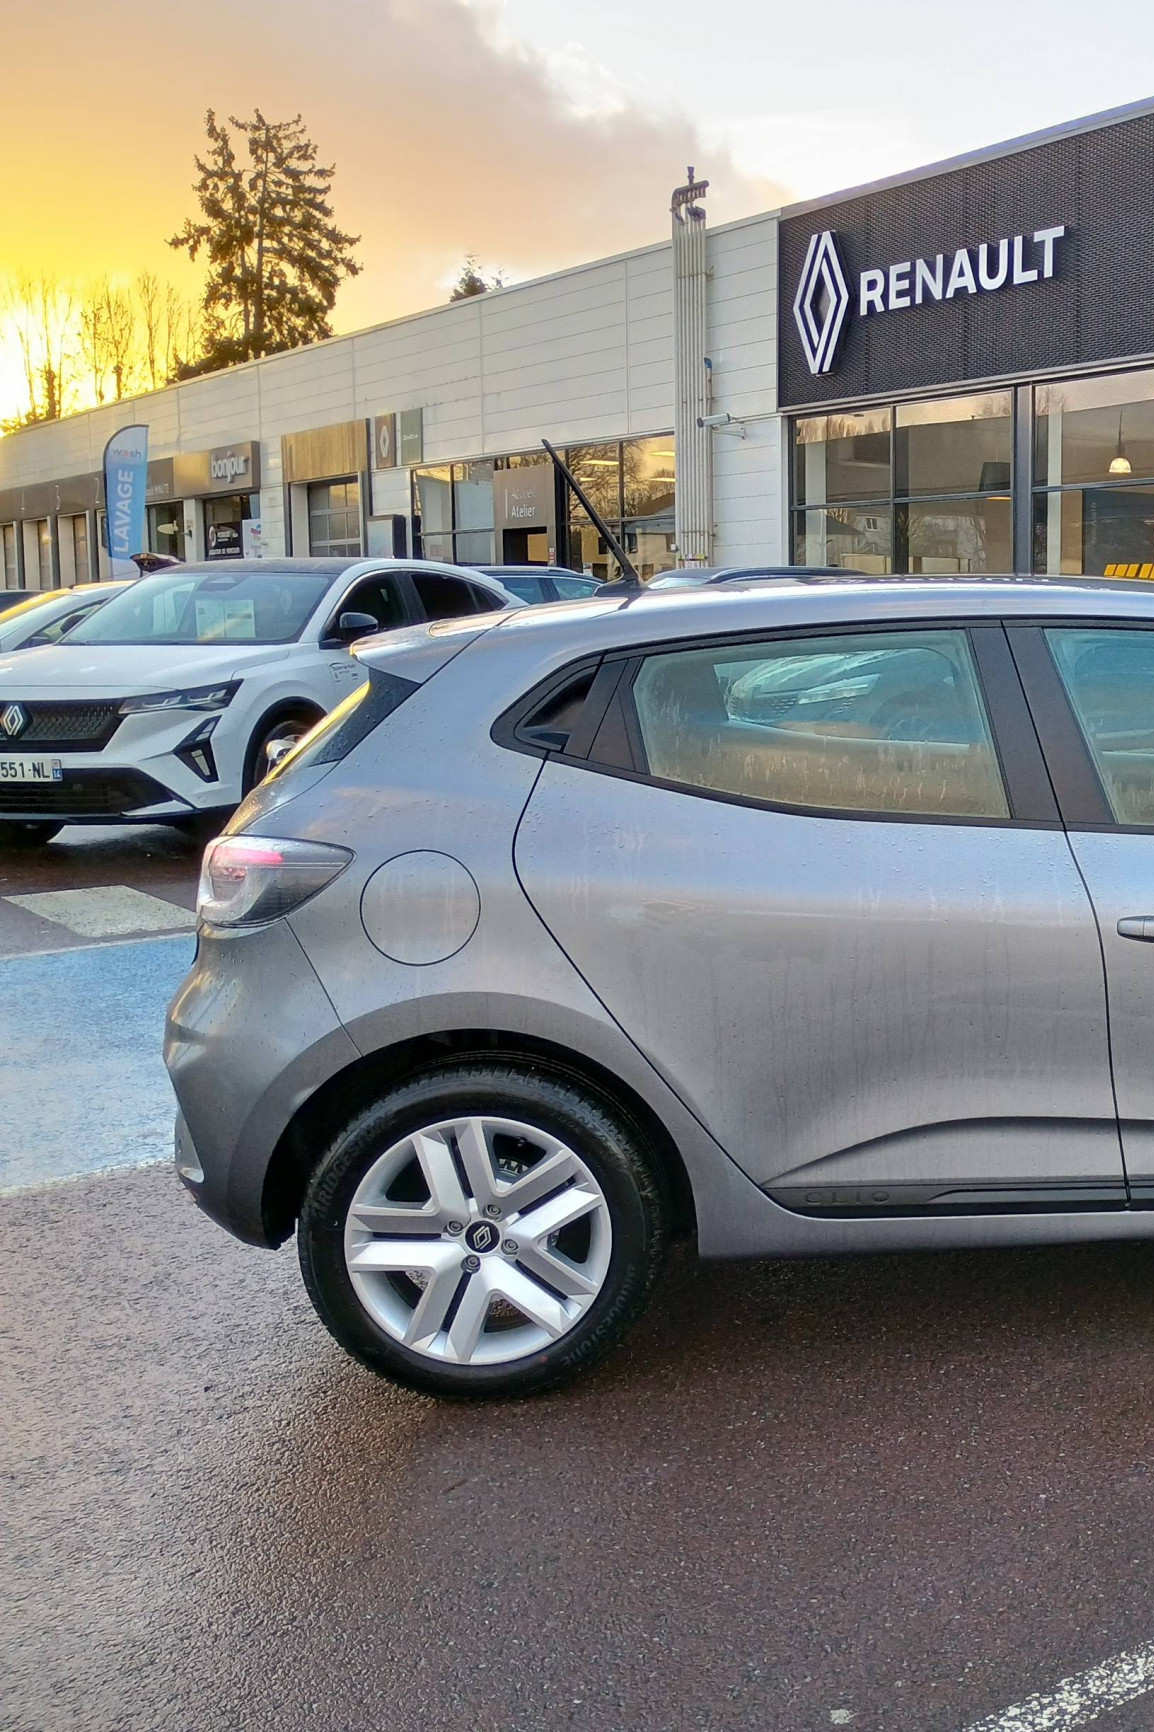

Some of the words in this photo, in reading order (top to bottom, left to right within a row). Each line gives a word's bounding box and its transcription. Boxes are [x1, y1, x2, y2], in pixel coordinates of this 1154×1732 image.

[859, 225, 1065, 316] RENAULT
[112, 449, 142, 459] wash
[211, 451, 246, 483] bonjour
[113, 468, 135, 552] LAVAGE
[511, 503, 536, 518] Atelier
[804, 1190, 890, 1205] CLIO
